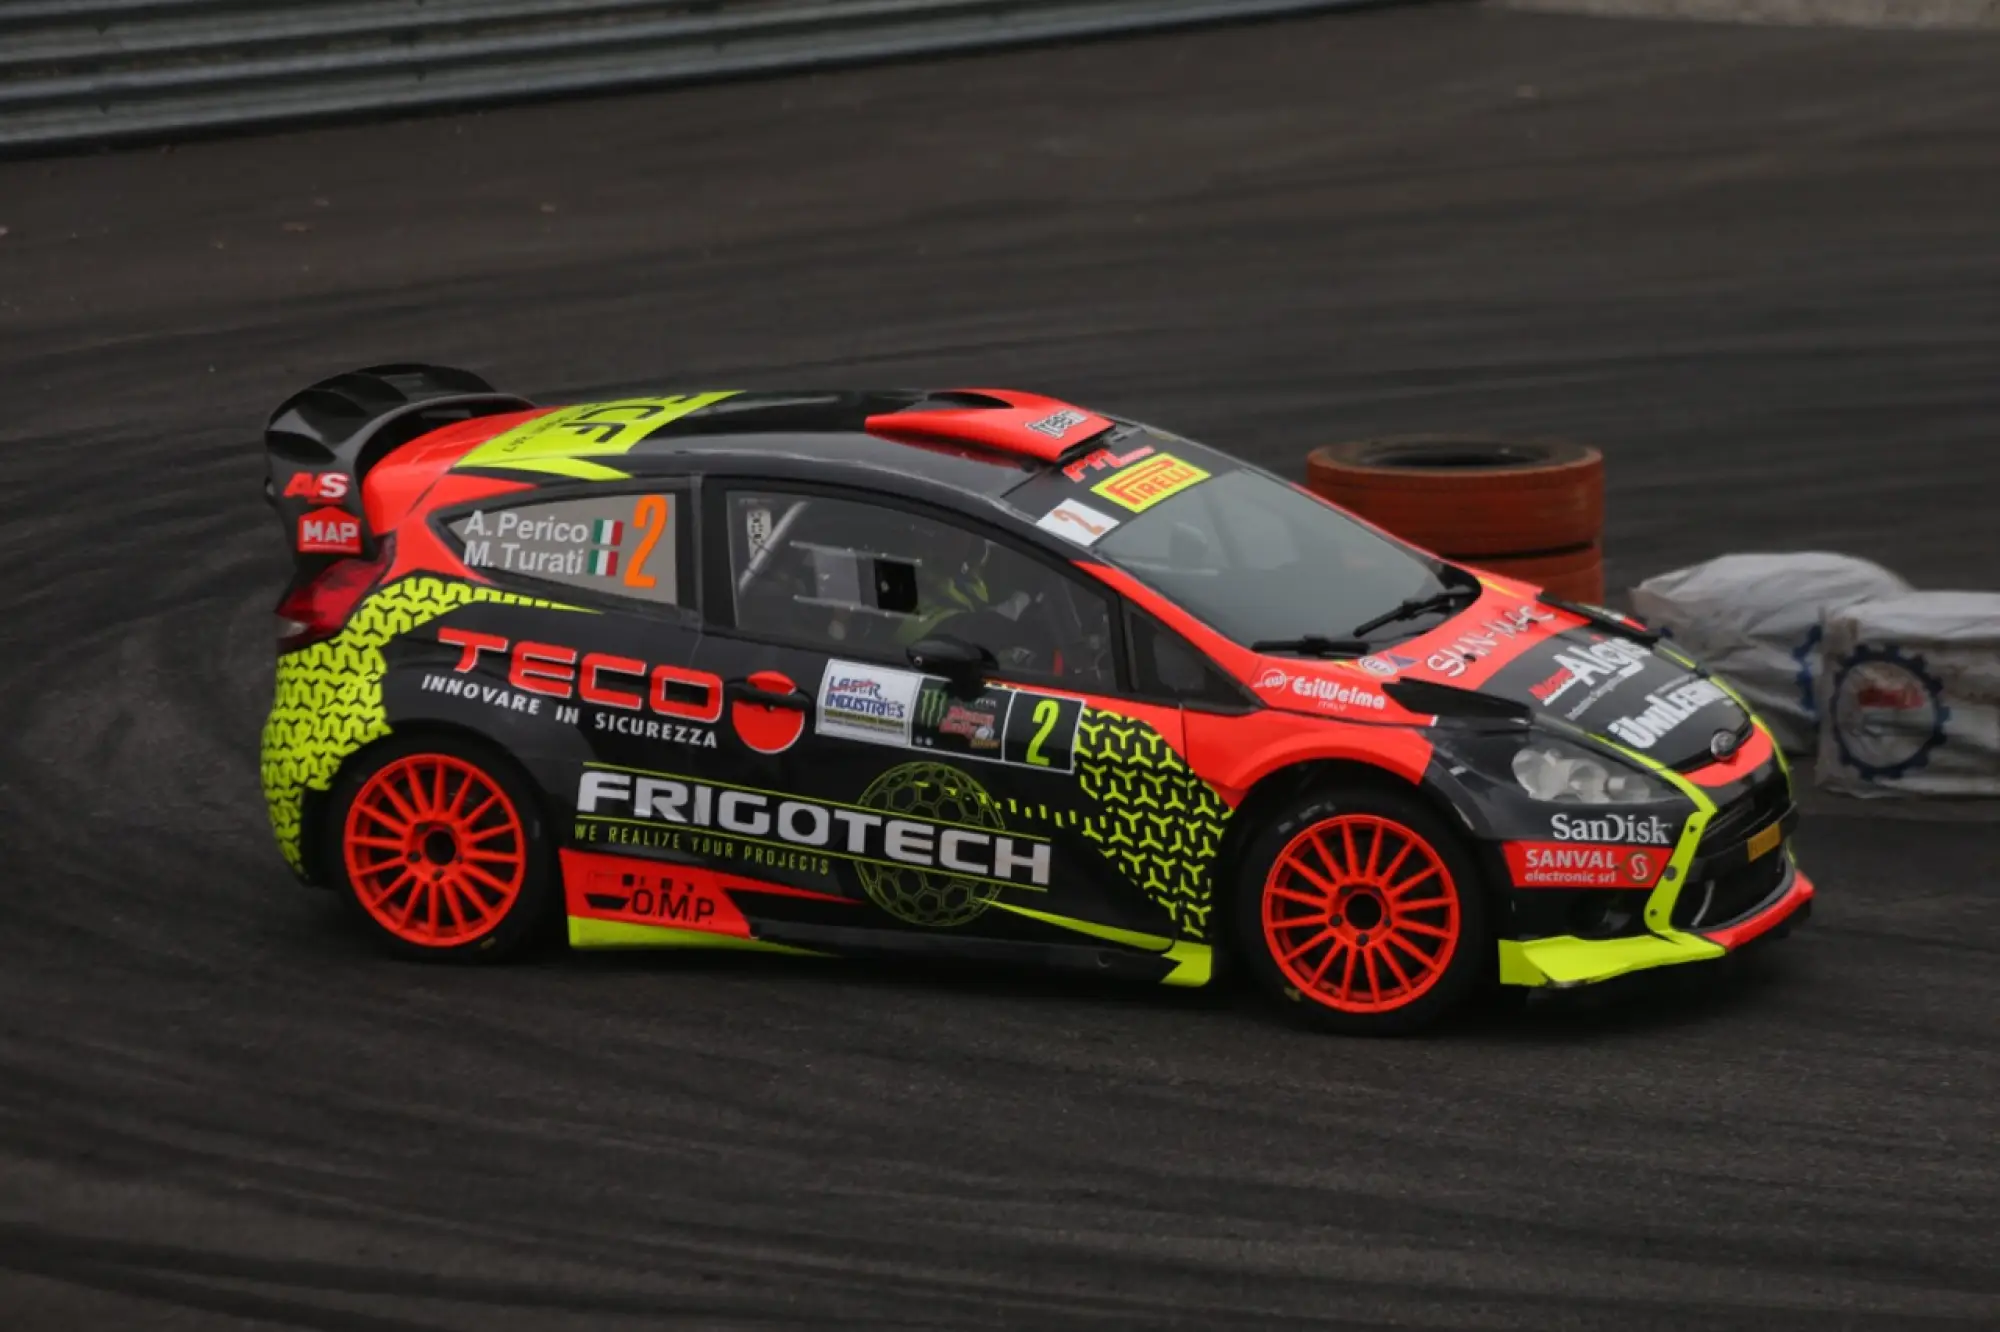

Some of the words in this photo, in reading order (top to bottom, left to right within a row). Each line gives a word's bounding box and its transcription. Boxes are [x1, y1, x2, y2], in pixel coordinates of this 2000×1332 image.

[1104, 459, 1197, 505] PIRELLI
[303, 519, 357, 543] MAP
[464, 510, 493, 537] A.
[497, 512, 589, 543] Perico
[623, 494, 669, 589] 2
[464, 540, 494, 568] M.
[501, 543, 583, 574] Turati
[437, 626, 723, 723] TECO
[421, 673, 541, 715] INNOVARE
[555, 704, 580, 725] IN
[594, 711, 718, 749] SICUREZZA
[824, 692, 905, 718] INDUSTRIES
[1026, 699, 1061, 766] 2
[577, 770, 1051, 885] FRIGOTECH
[1550, 813, 1672, 844] SanDisk
[574, 824, 597, 842] WE
[692, 836, 733, 858] YOUR
[744, 845, 829, 875] PROJECTS
[1525, 849, 1616, 868] SANVAL
[1525, 870, 1594, 882] electronic
[1597, 871, 1616, 883] srl
